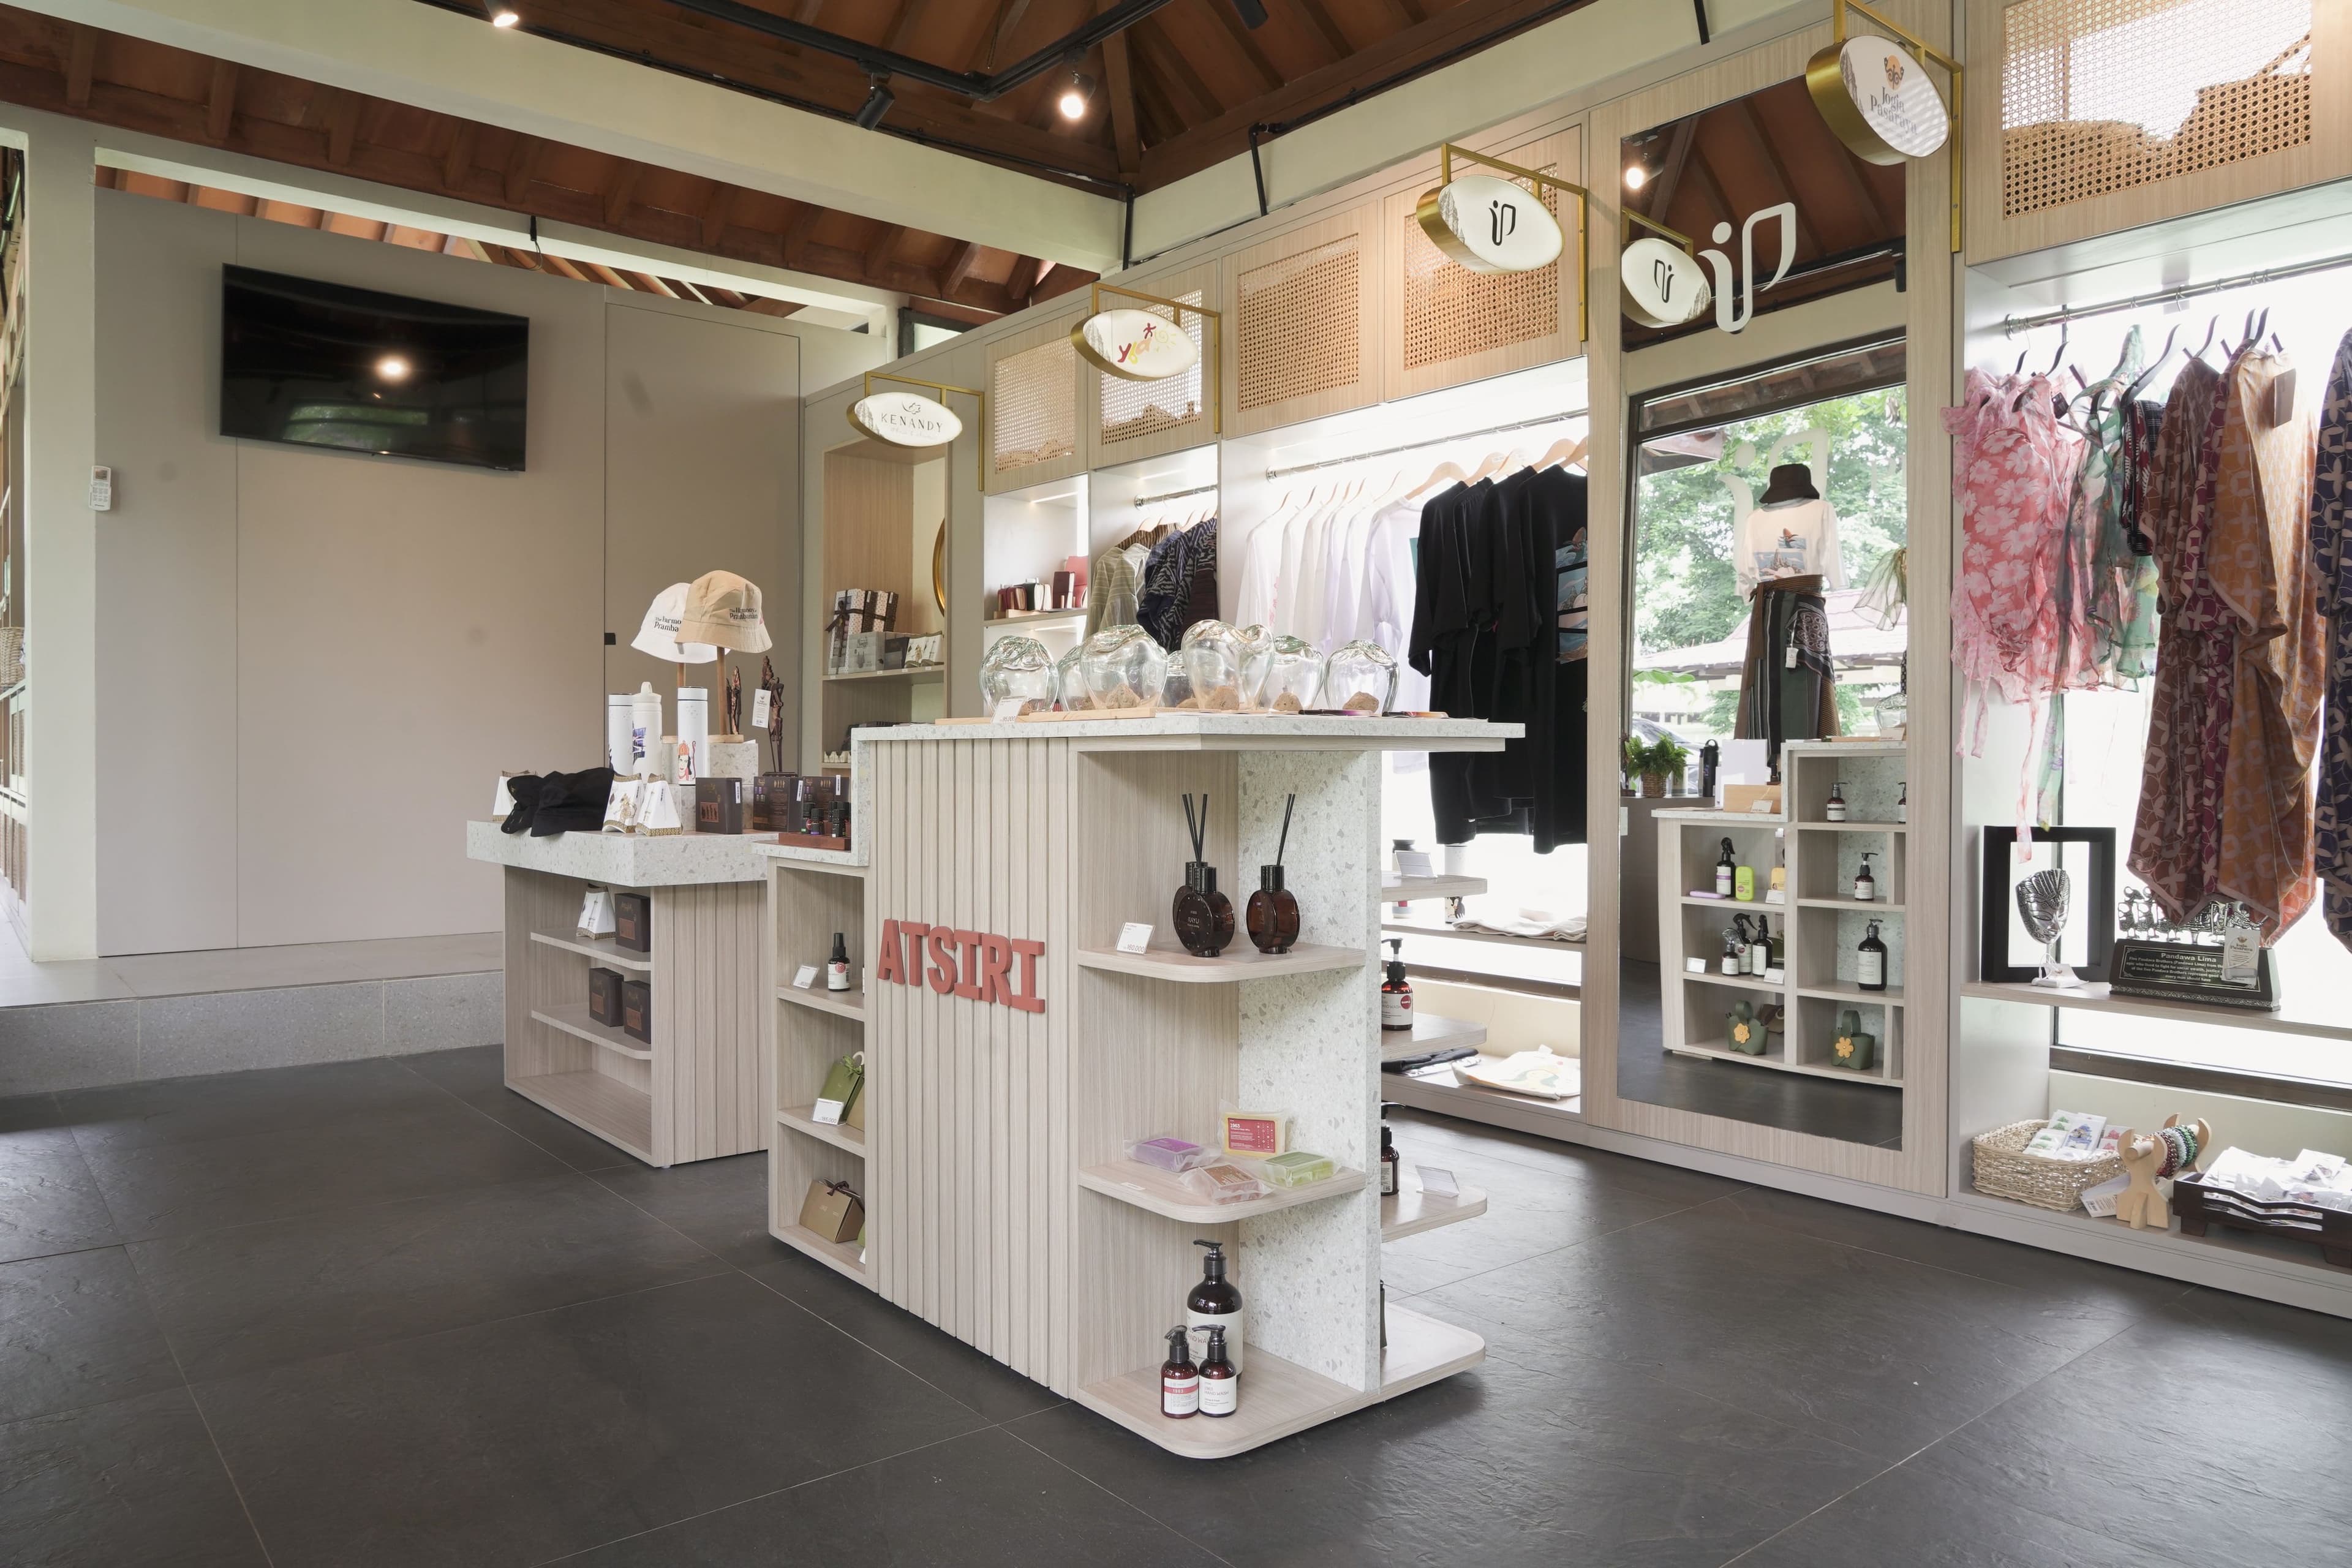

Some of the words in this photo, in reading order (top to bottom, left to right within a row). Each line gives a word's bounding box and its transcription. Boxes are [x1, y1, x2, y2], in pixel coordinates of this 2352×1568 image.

[1870, 94, 1918, 135] Pasaraya
[881, 412, 943, 432] KENANDY
[654, 621, 679, 631] Pramba
[878, 919, 1045, 1013] ATSIRI
[2161, 952, 2196, 961] Pandawa
